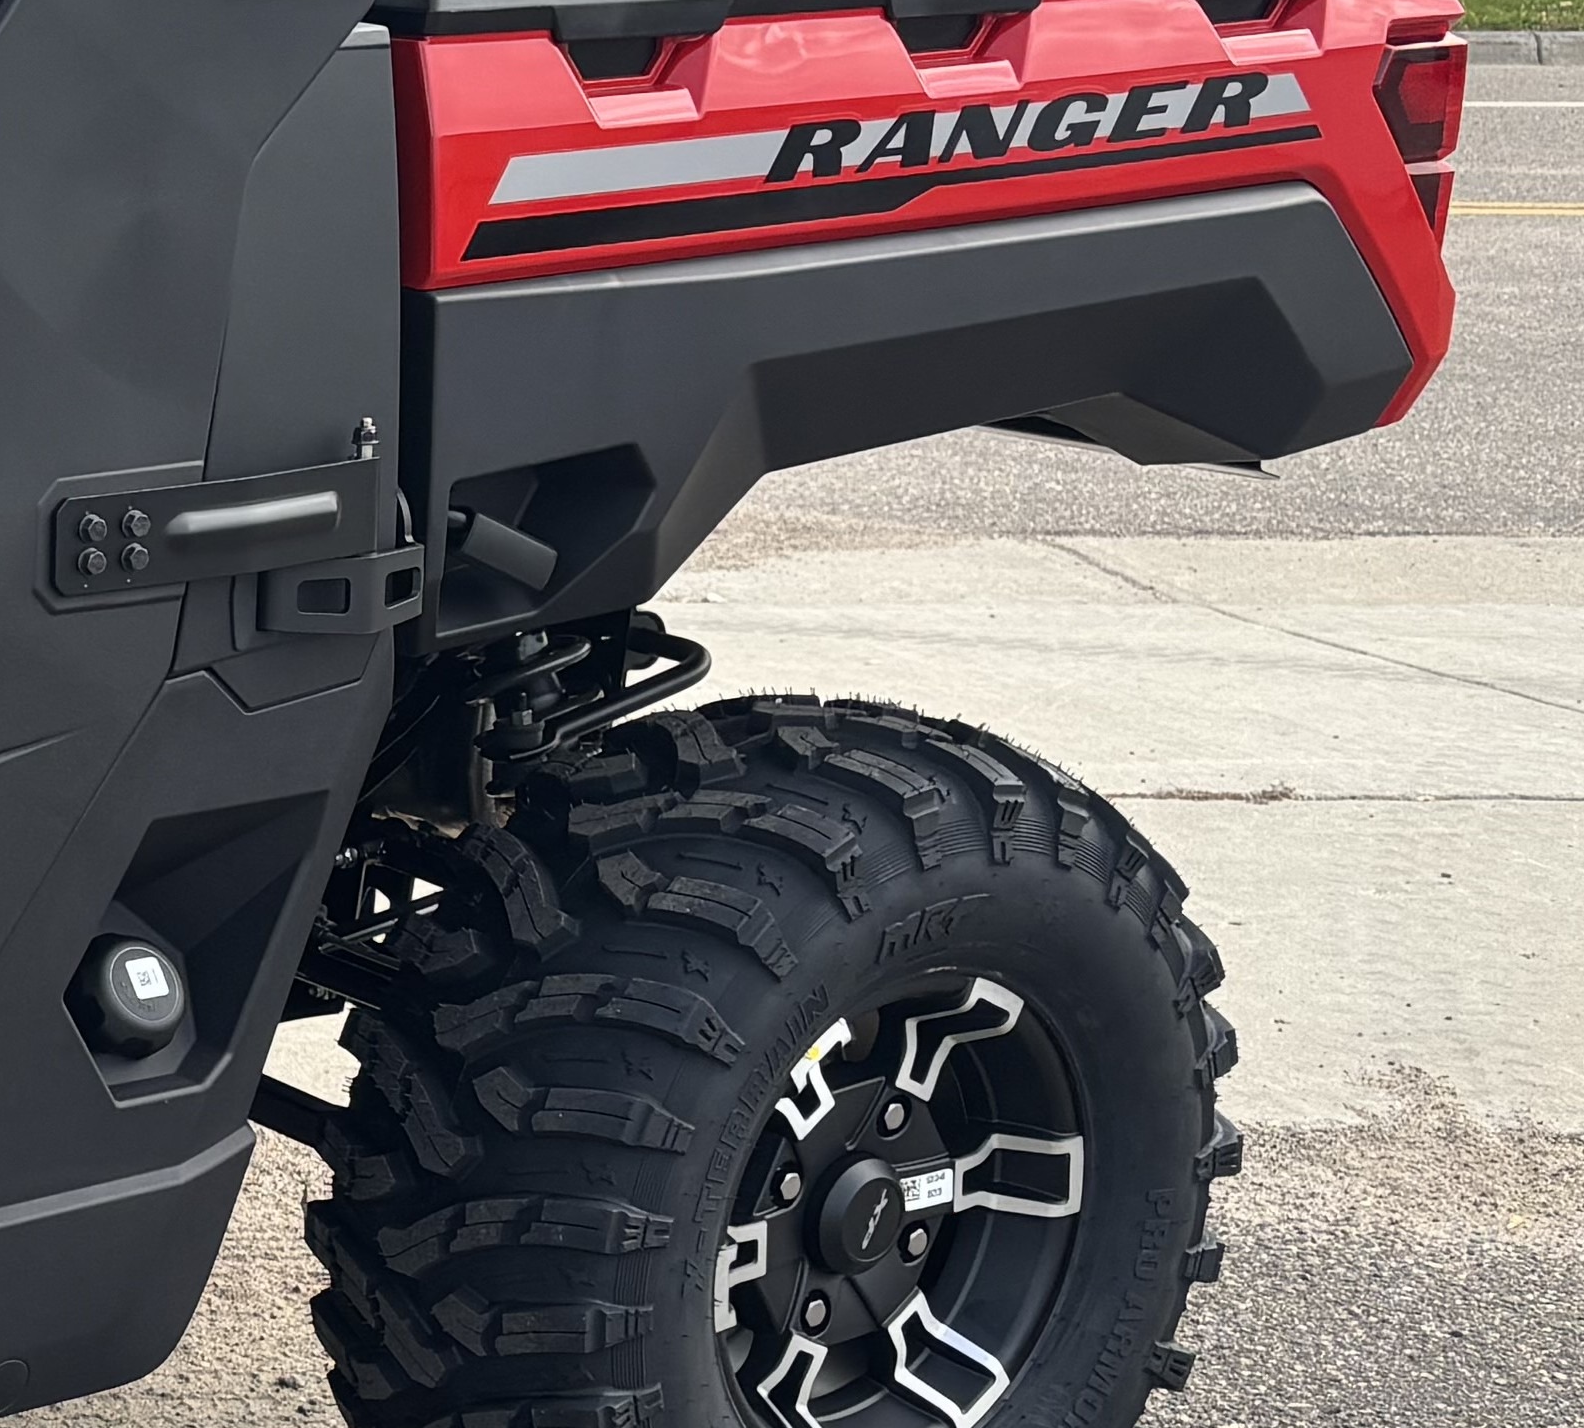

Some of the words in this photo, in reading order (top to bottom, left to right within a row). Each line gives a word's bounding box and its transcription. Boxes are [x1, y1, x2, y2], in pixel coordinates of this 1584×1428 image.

[765, 72, 1268, 183] RANGER
[688, 987, 830, 1295] X-TERRAIN
[1134, 1186, 1175, 1280] PRO
